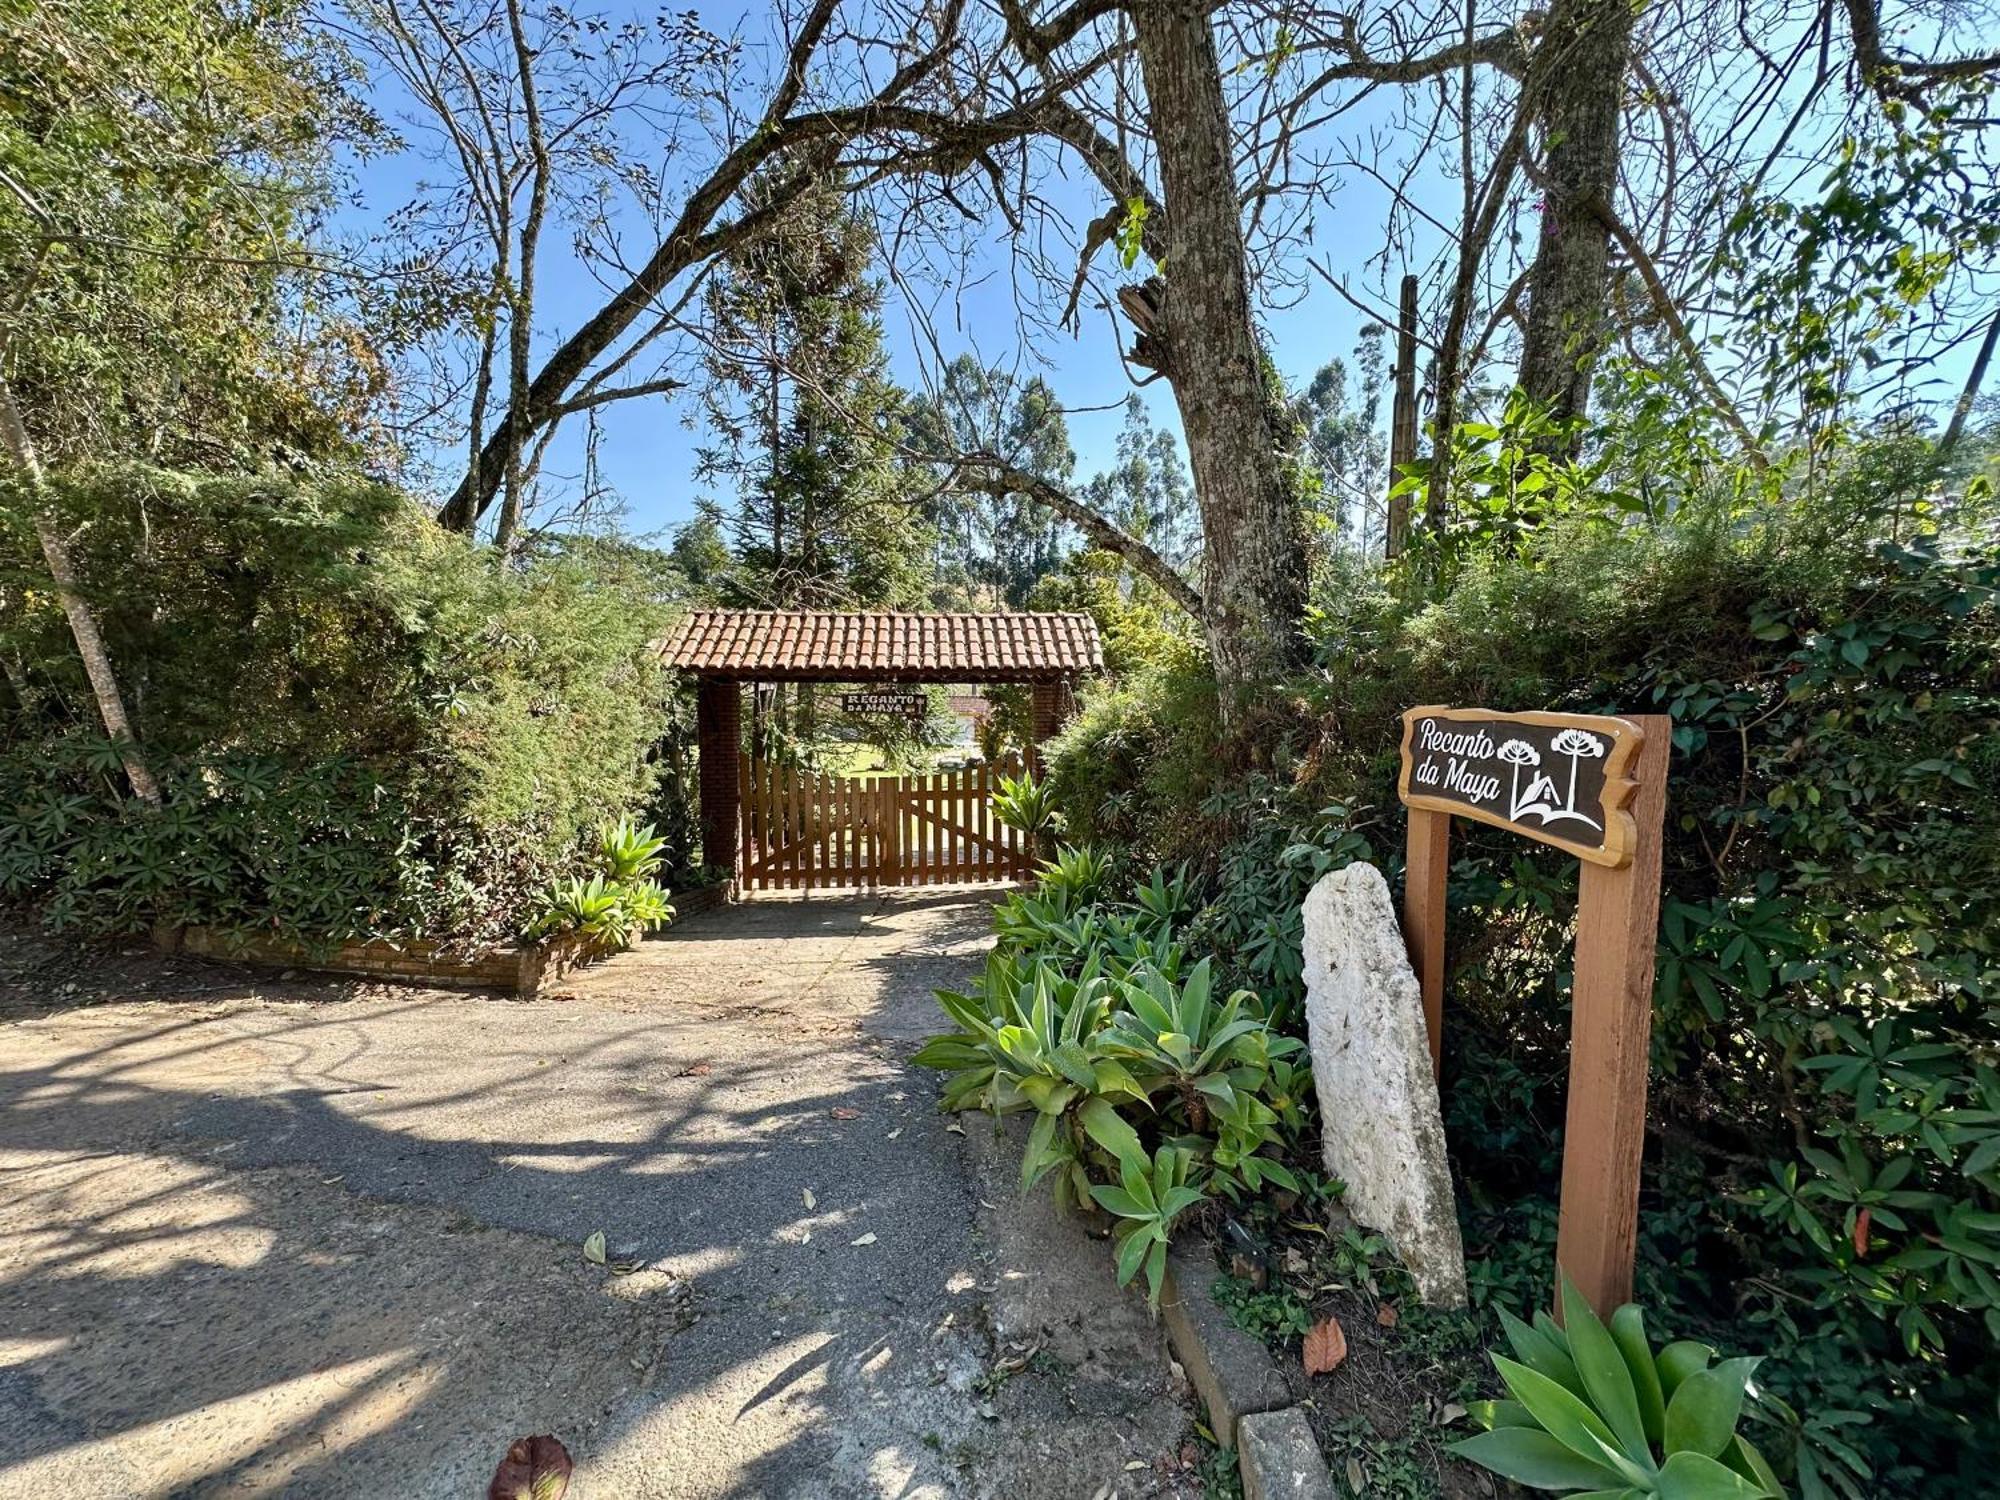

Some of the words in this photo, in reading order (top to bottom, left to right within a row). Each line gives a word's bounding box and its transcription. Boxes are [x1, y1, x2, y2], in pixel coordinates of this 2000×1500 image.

[847, 695, 914, 704] RECANTO
[865, 704, 903, 712] MAYA
[1420, 718, 1495, 760] Recanto
[1416, 755, 1440, 785] da
[1443, 758, 1501, 804] Maya
